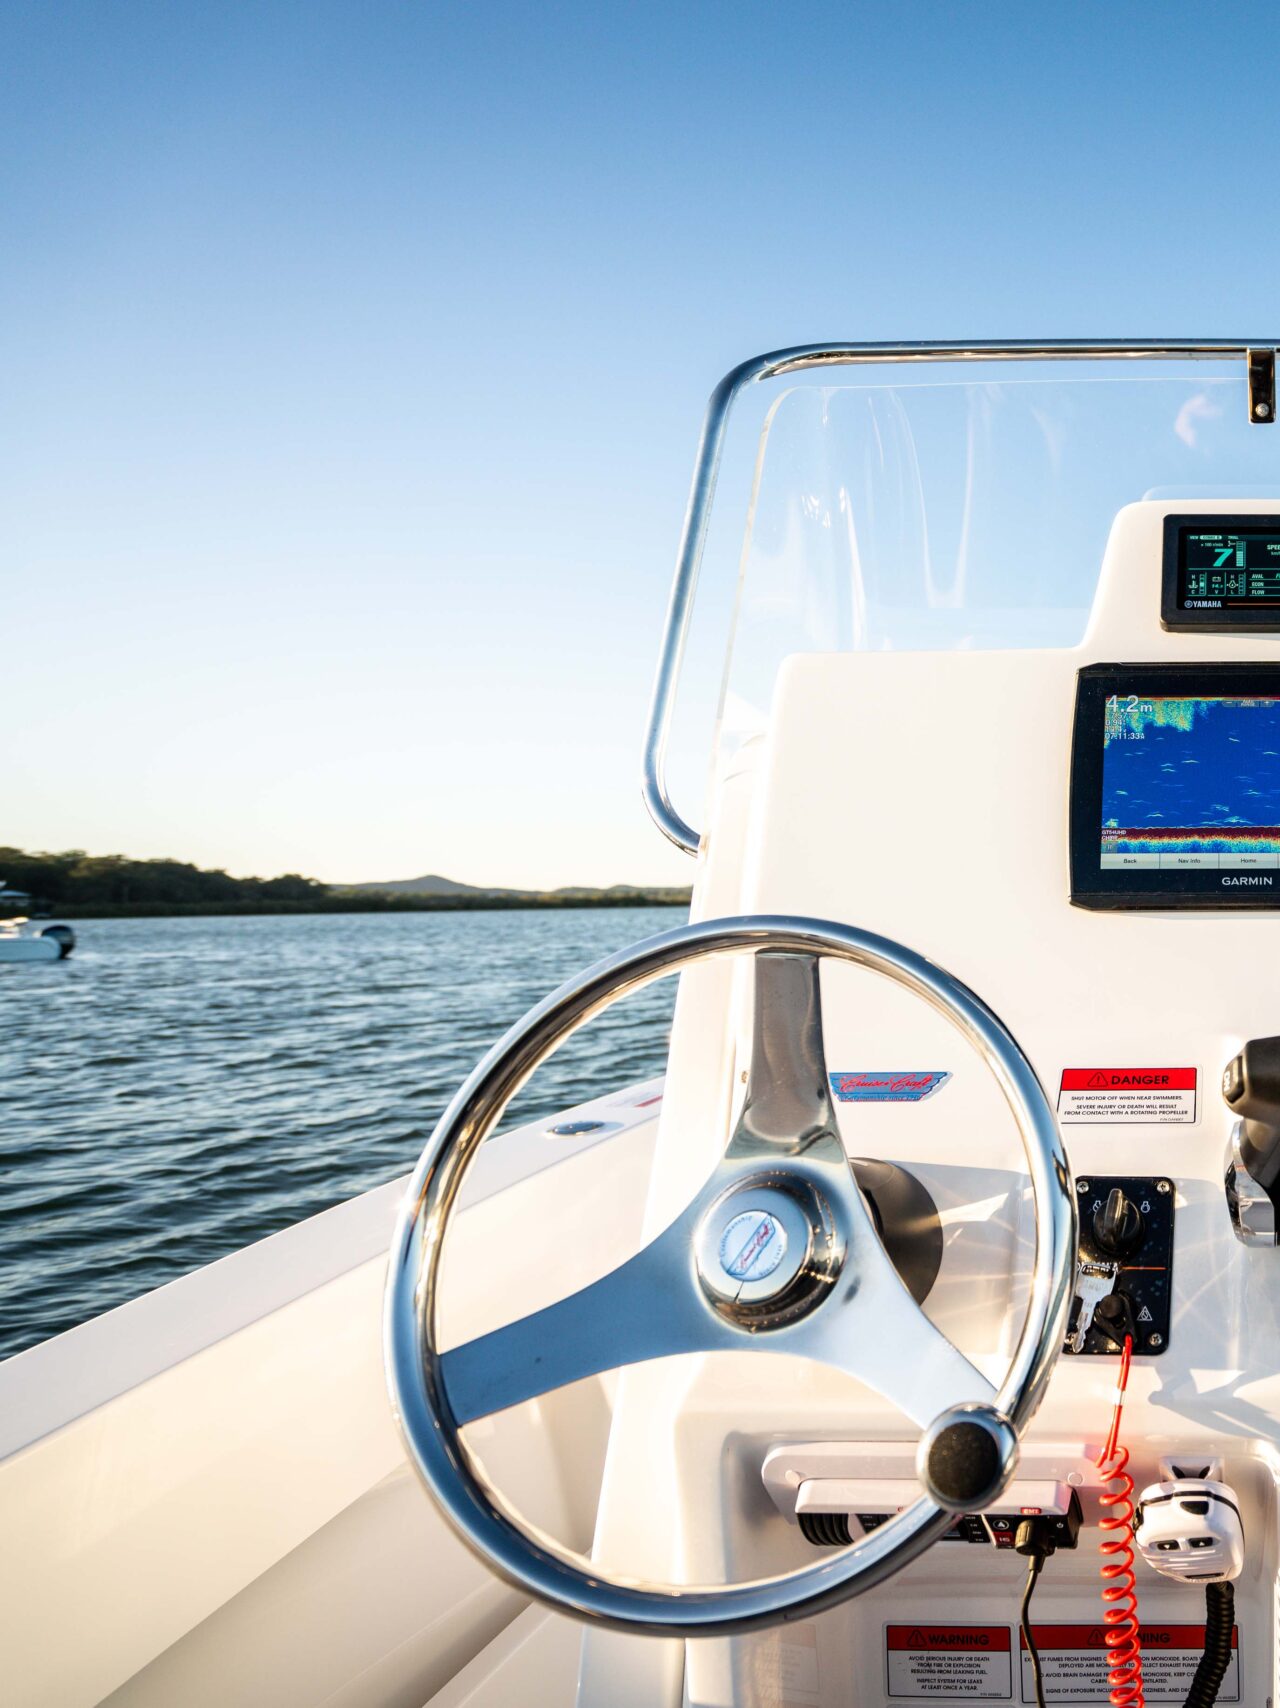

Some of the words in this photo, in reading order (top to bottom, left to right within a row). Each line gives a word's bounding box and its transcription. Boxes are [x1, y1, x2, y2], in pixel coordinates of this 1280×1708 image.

[1213, 548, 1234, 566] 7
[1222, 877, 1272, 886] GARMIN
[890, 1074, 933, 1092] Craft
[1111, 1076, 1169, 1085] DANGER
[928, 1635, 989, 1645] WARNING
